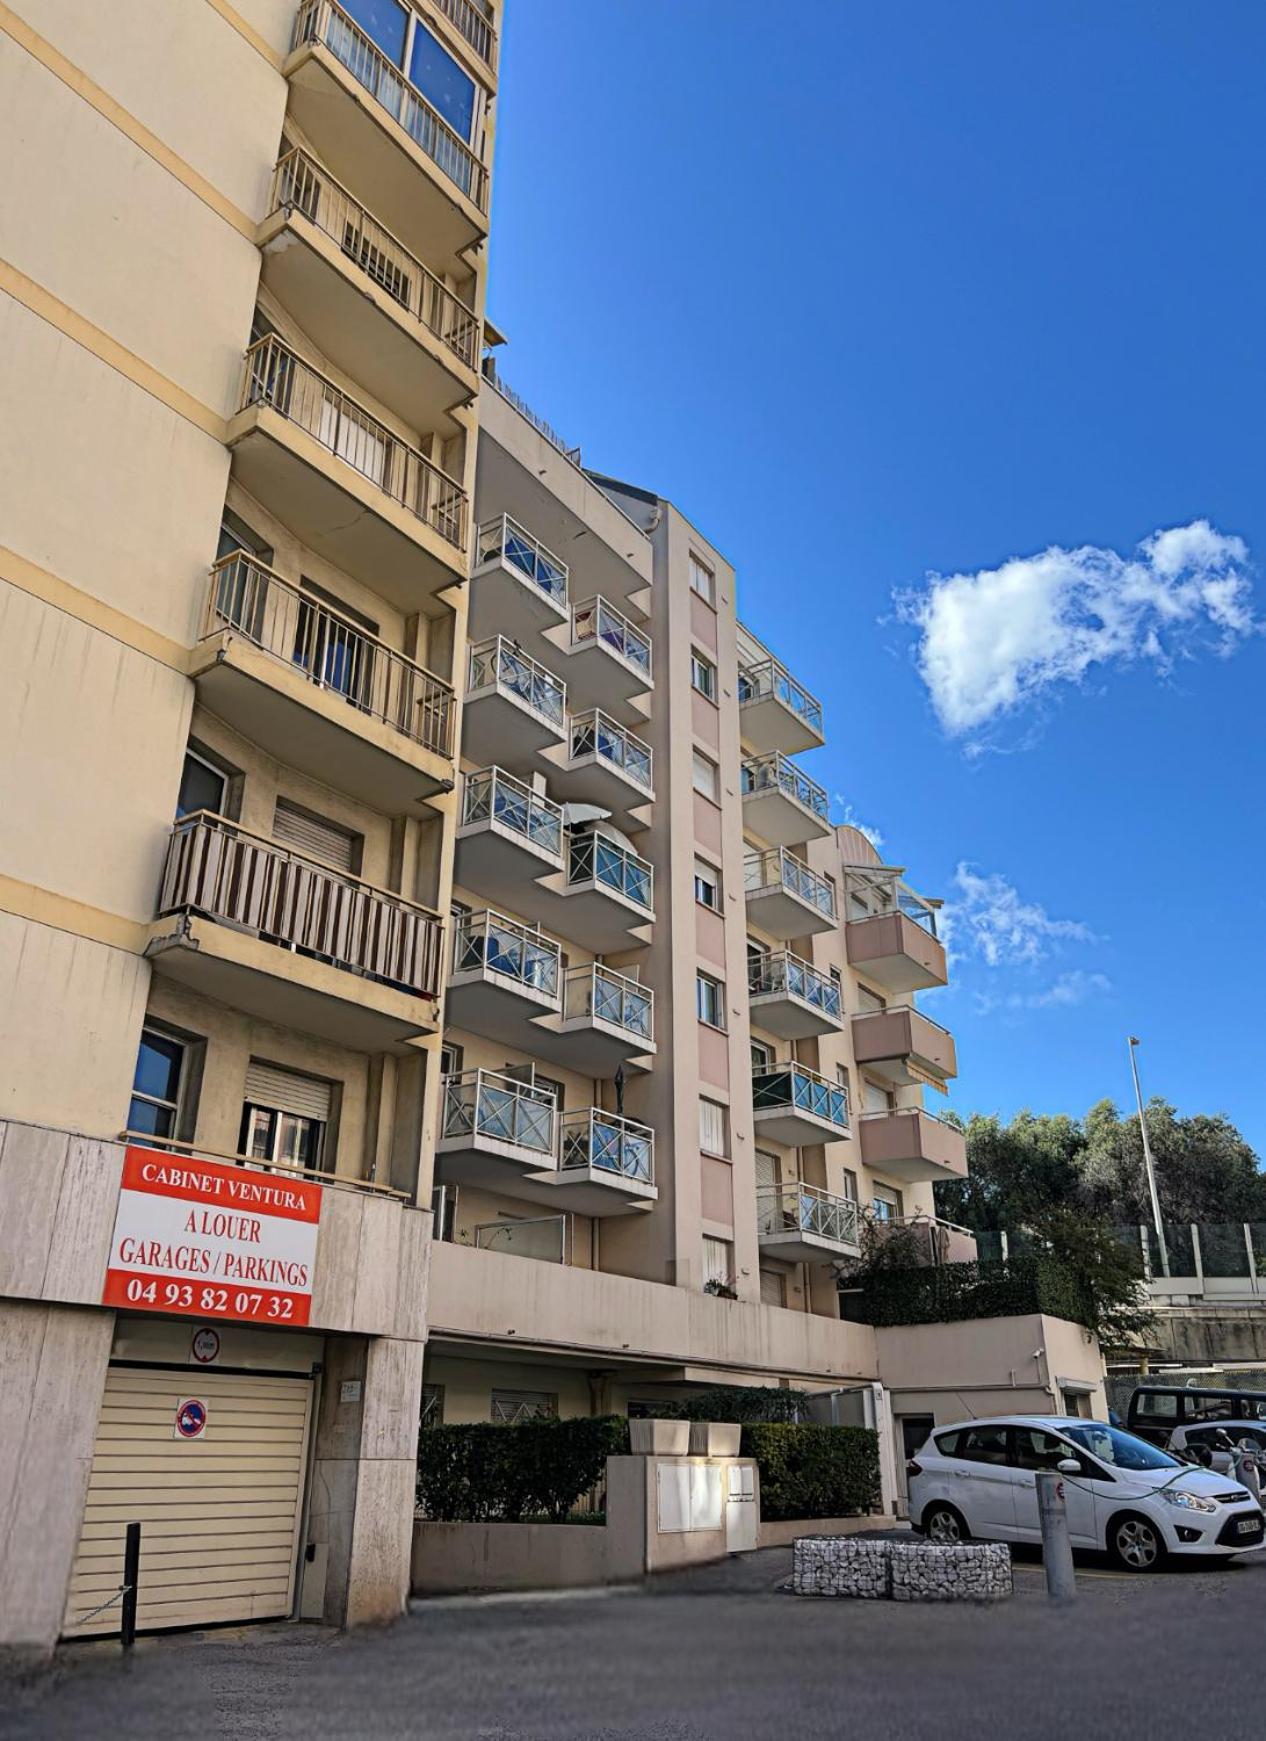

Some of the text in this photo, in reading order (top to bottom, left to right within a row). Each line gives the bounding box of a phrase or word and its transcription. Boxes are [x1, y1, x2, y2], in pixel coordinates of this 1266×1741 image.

[142, 1163, 307, 1211] CABINET VENTURA
[183, 1208, 261, 1244] A LOUER
[119, 1237, 211, 1274] GARAGES
[223, 1252, 308, 1287] PARKINGS
[127, 1278, 293, 1319] 04 93 82 07 32
